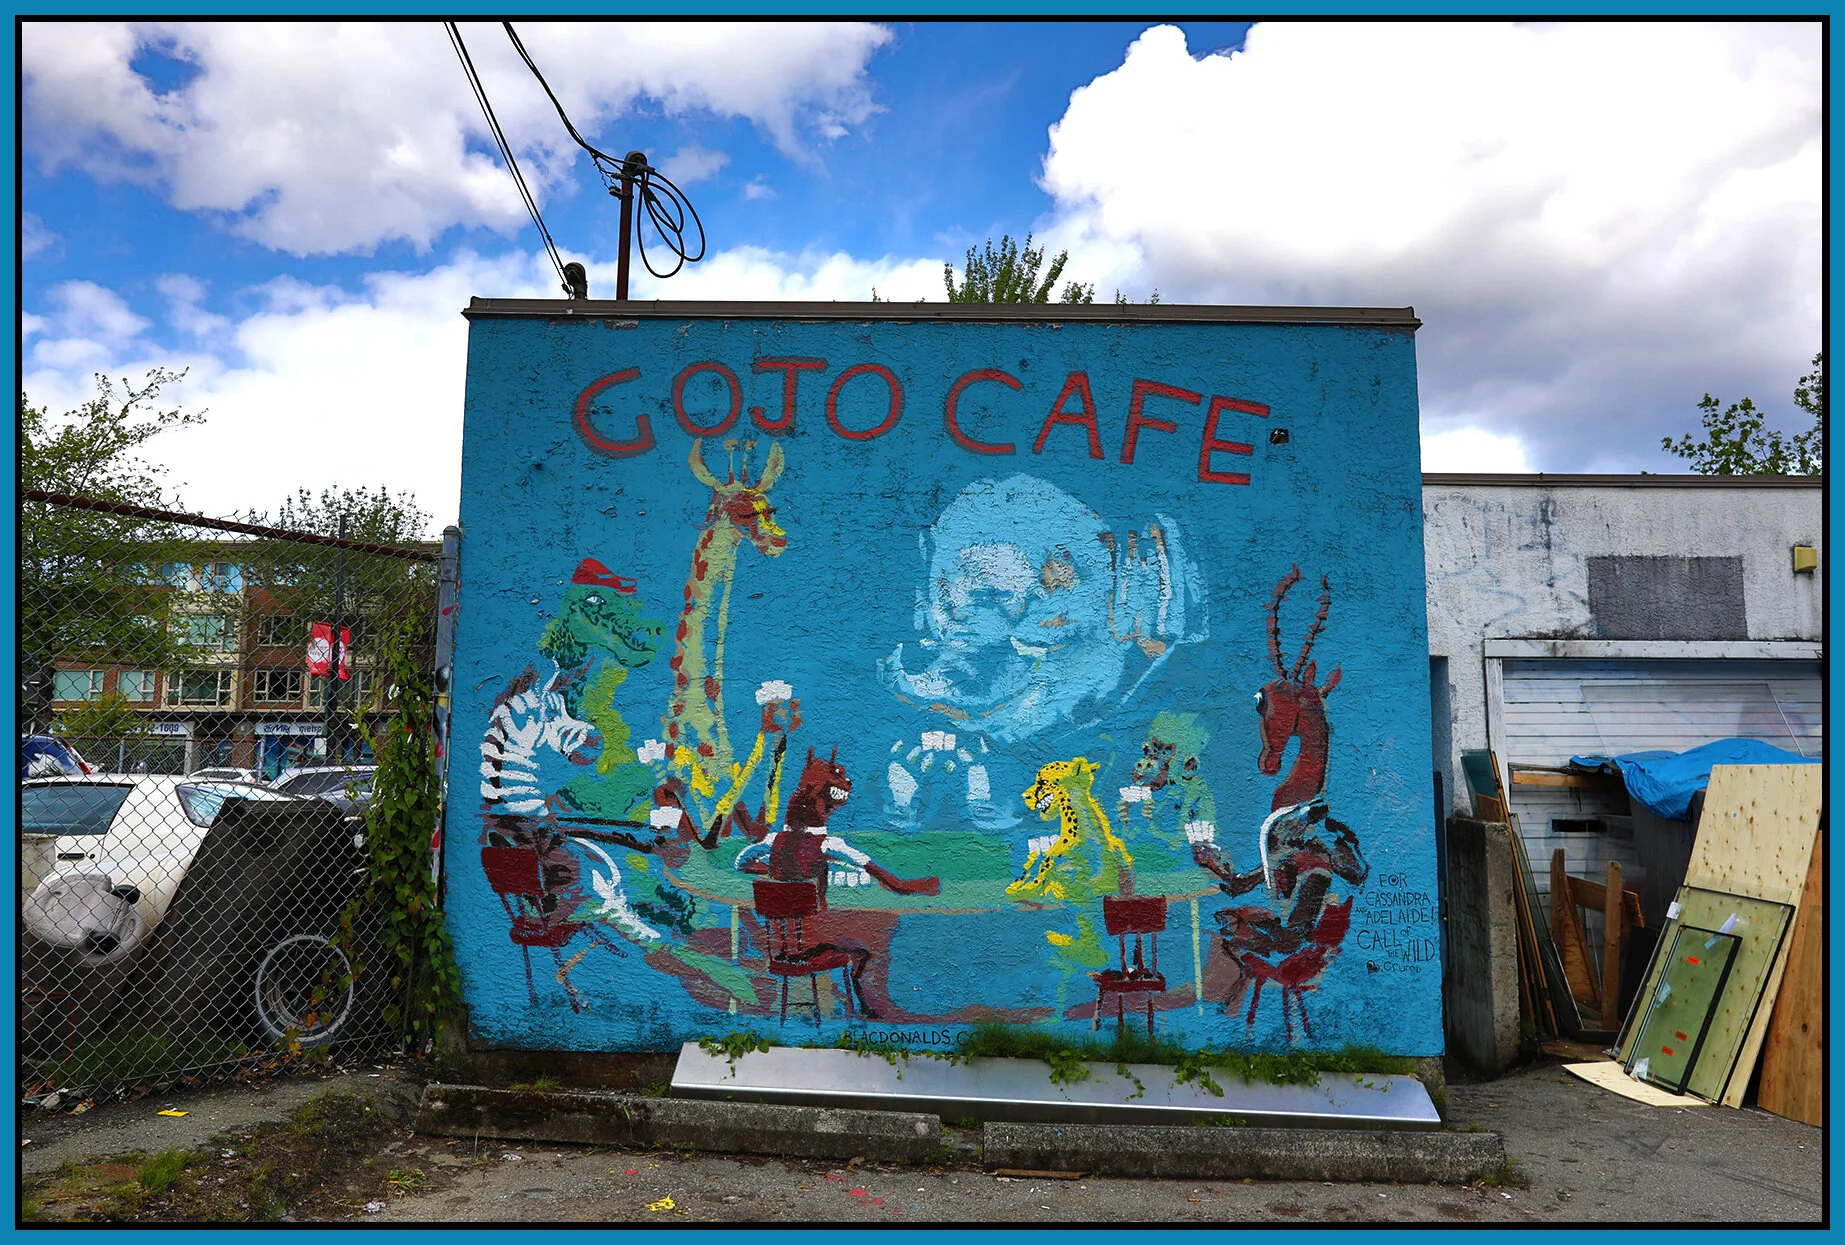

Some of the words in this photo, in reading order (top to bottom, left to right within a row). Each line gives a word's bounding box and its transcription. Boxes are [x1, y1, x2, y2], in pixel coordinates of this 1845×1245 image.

[572, 357, 904, 459] GOJO
[945, 368, 1270, 486] CAFE
[1379, 873, 1408, 887] FOR
[1365, 891, 1431, 907] CASSANDRA
